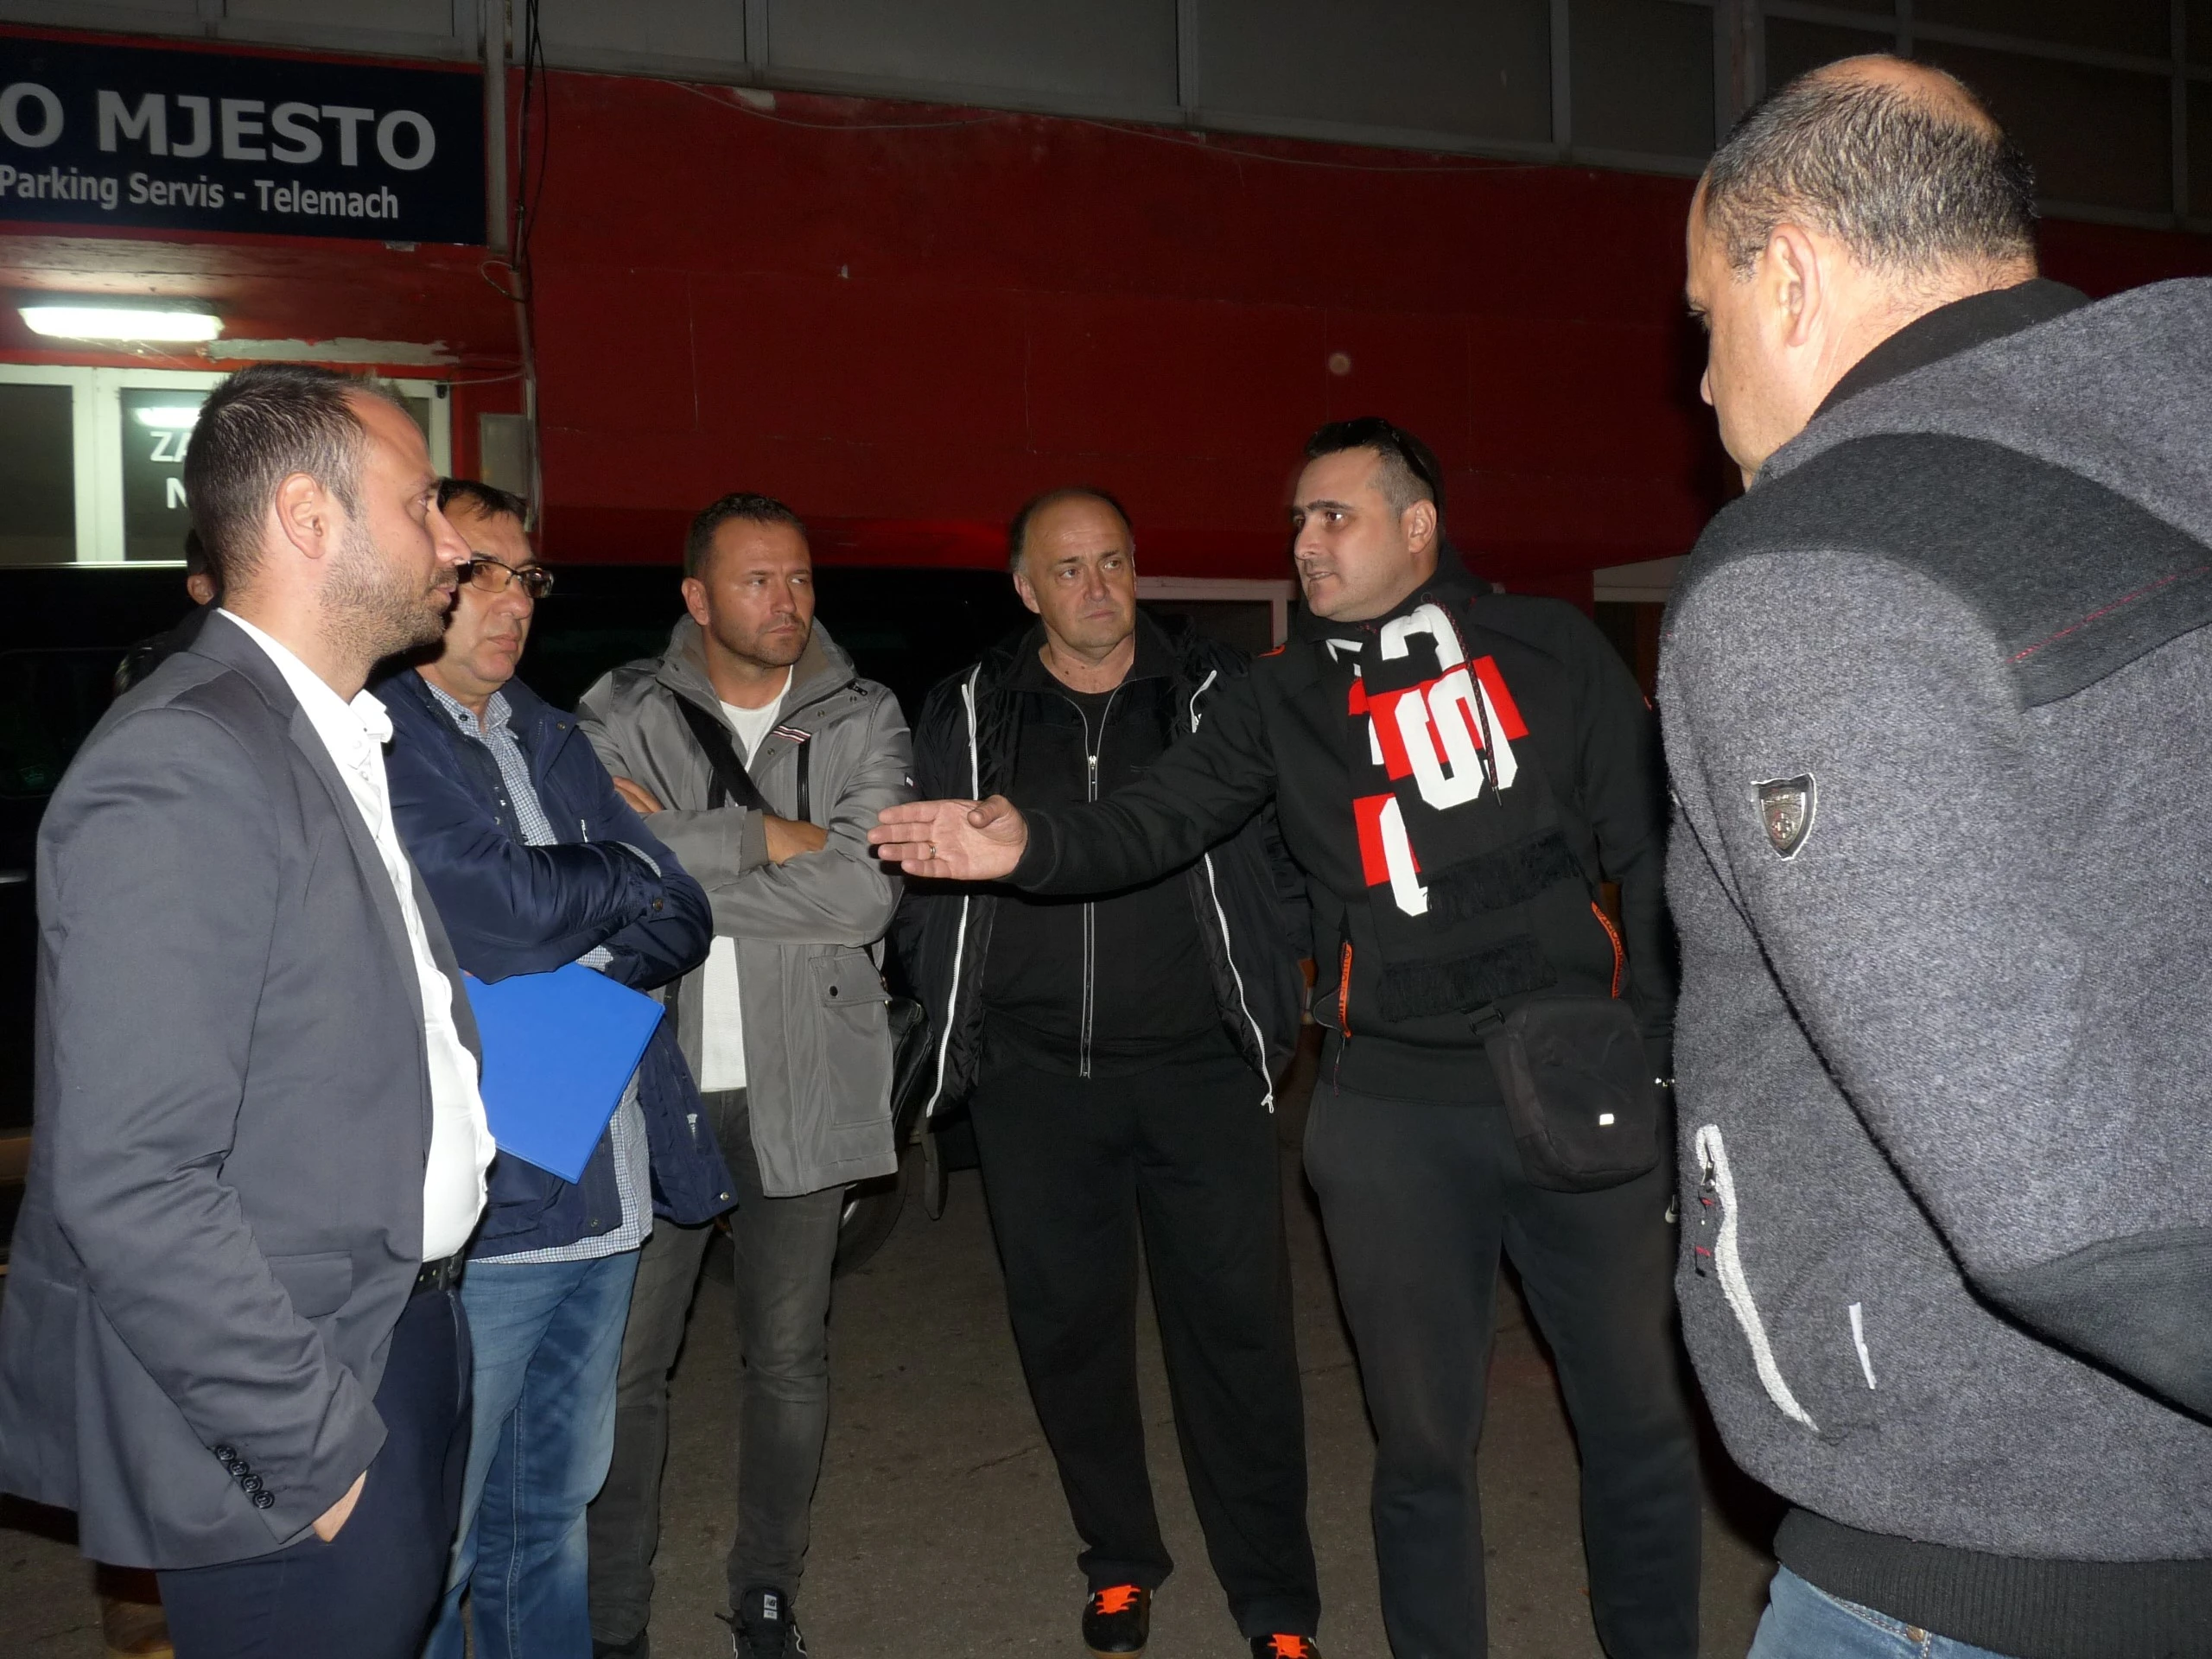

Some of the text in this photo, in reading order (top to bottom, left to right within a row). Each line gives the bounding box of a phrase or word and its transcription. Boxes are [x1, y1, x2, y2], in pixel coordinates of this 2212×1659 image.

[96, 89, 436, 170] MJESTO
[0, 164, 118, 210] Parking
[129, 172, 225, 208] Servis
[254, 179, 399, 219] Telemach
